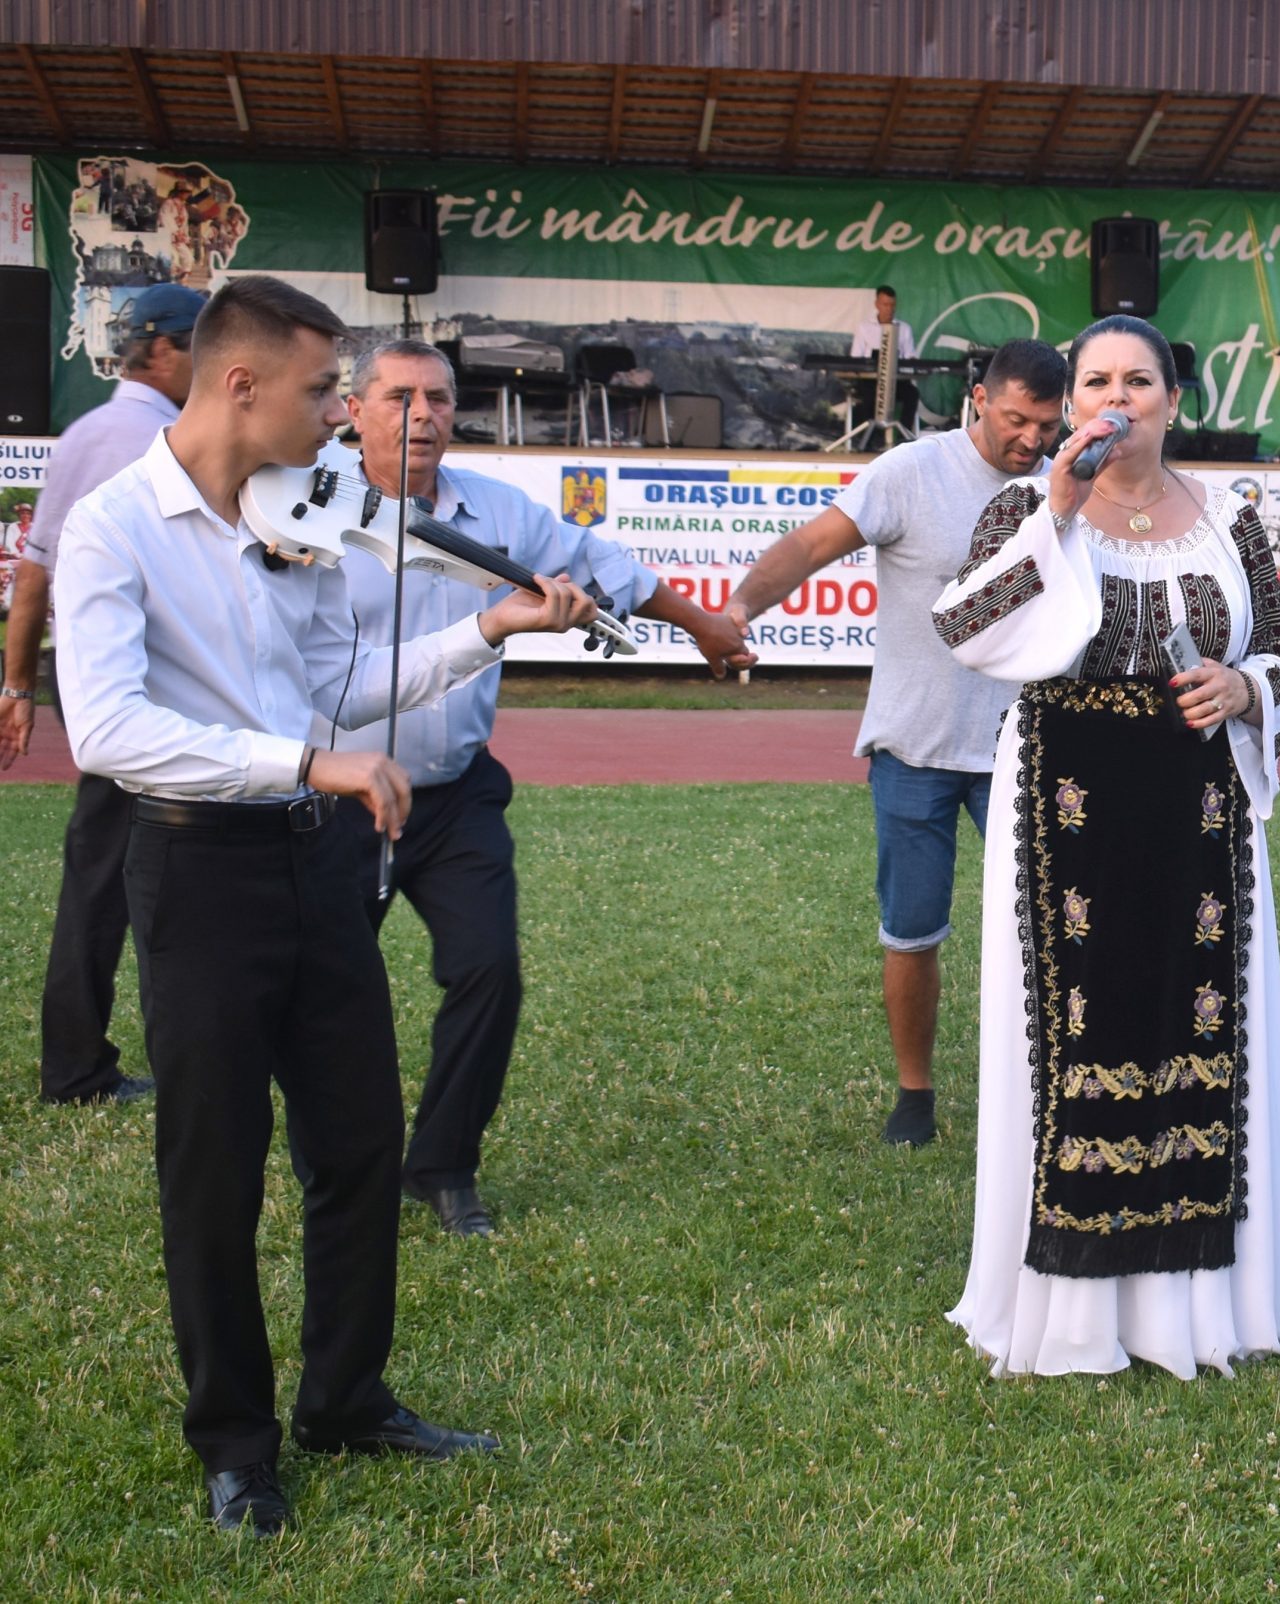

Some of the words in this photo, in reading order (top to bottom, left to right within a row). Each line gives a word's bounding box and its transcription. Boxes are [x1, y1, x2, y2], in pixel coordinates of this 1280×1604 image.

[436, 189, 532, 238] Fii
[540, 188, 829, 248] mândru
[835, 201, 924, 253] de
[934, 210, 1133, 273] orașu
[879, 331, 890, 417] TRADITIONAL
[644, 484, 768, 508] ORAŞUL
[776, 486, 845, 506] COS
[617, 514, 724, 532] PRIMĂRIA
[413, 559, 445, 572] ZETA
[728, 549, 765, 564] NA
[764, 579, 878, 616] UDO
